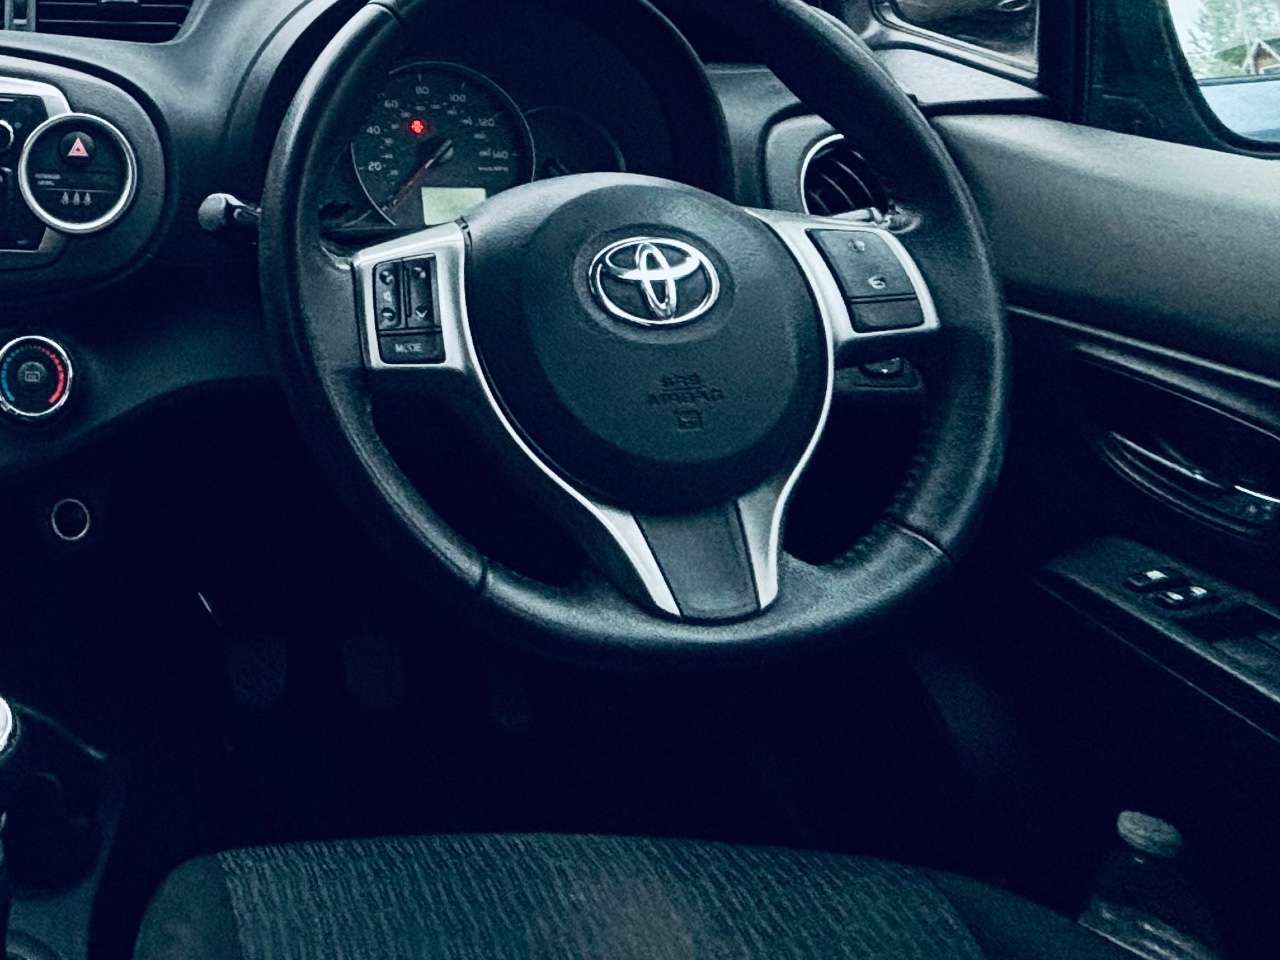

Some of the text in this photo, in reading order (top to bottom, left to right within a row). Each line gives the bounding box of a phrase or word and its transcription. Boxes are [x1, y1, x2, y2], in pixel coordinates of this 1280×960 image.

[449, 94, 467, 103] 100
[366, 125, 381, 135] 40
[368, 161, 382, 172] 20
